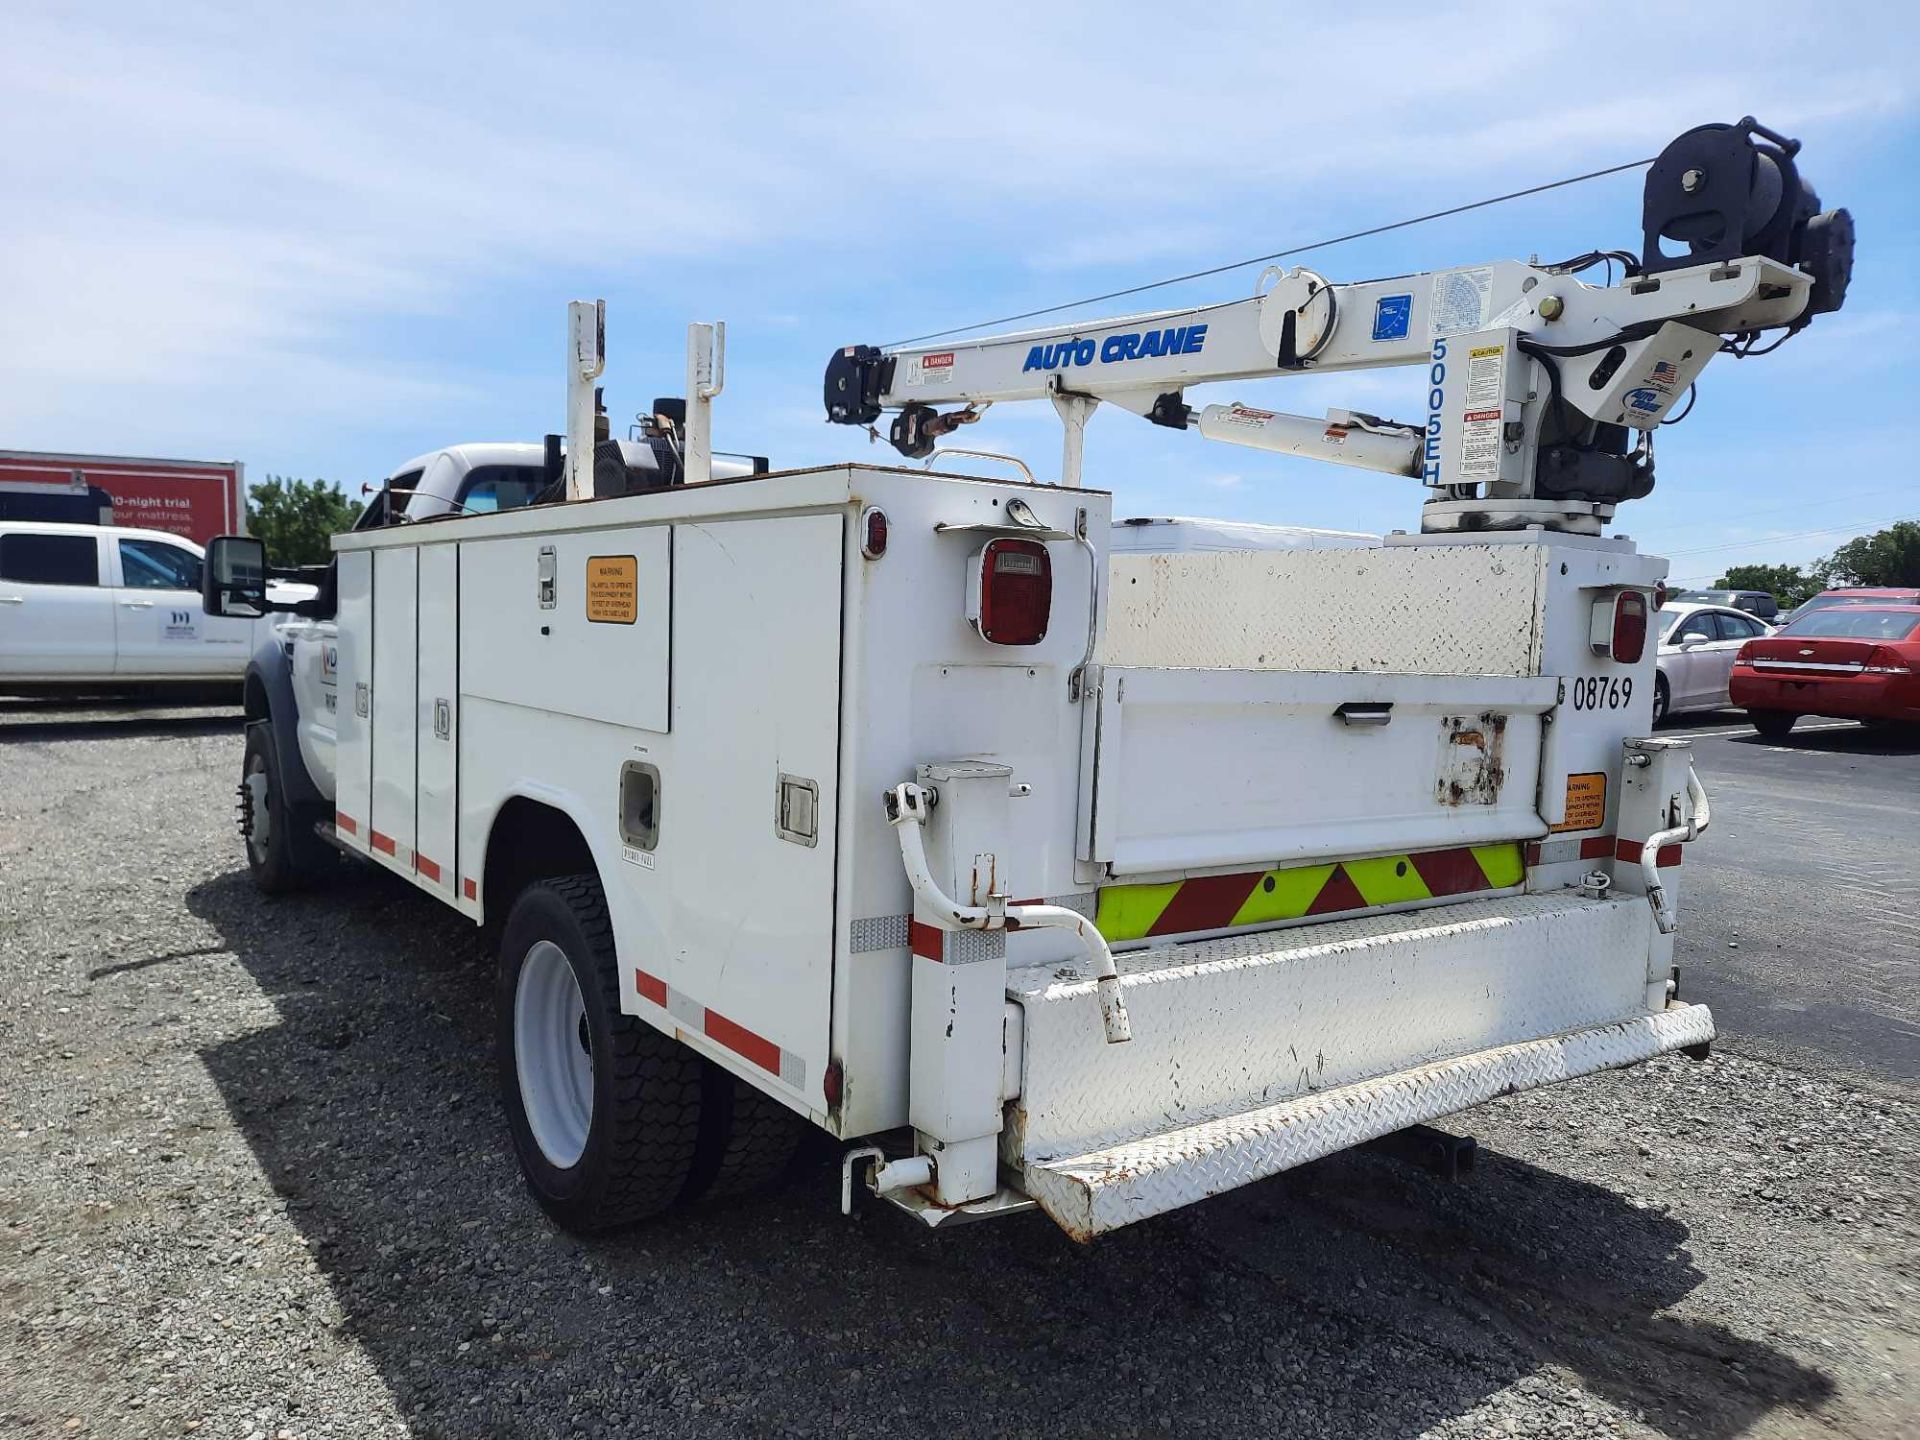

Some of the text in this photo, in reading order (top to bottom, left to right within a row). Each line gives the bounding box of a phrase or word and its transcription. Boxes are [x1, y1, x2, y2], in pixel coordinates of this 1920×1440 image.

[1023, 324, 1208, 373] AUTO CRANE
[930, 356, 953, 366] DANGER
[1422, 338, 1447, 485] 5005EH
[111, 496, 190, 508] 0-night trial
[113, 511, 134, 520] our
[599, 567, 623, 577] WARNING
[1574, 677, 1633, 710] 08769
[1567, 783, 1591, 791] ARNING
